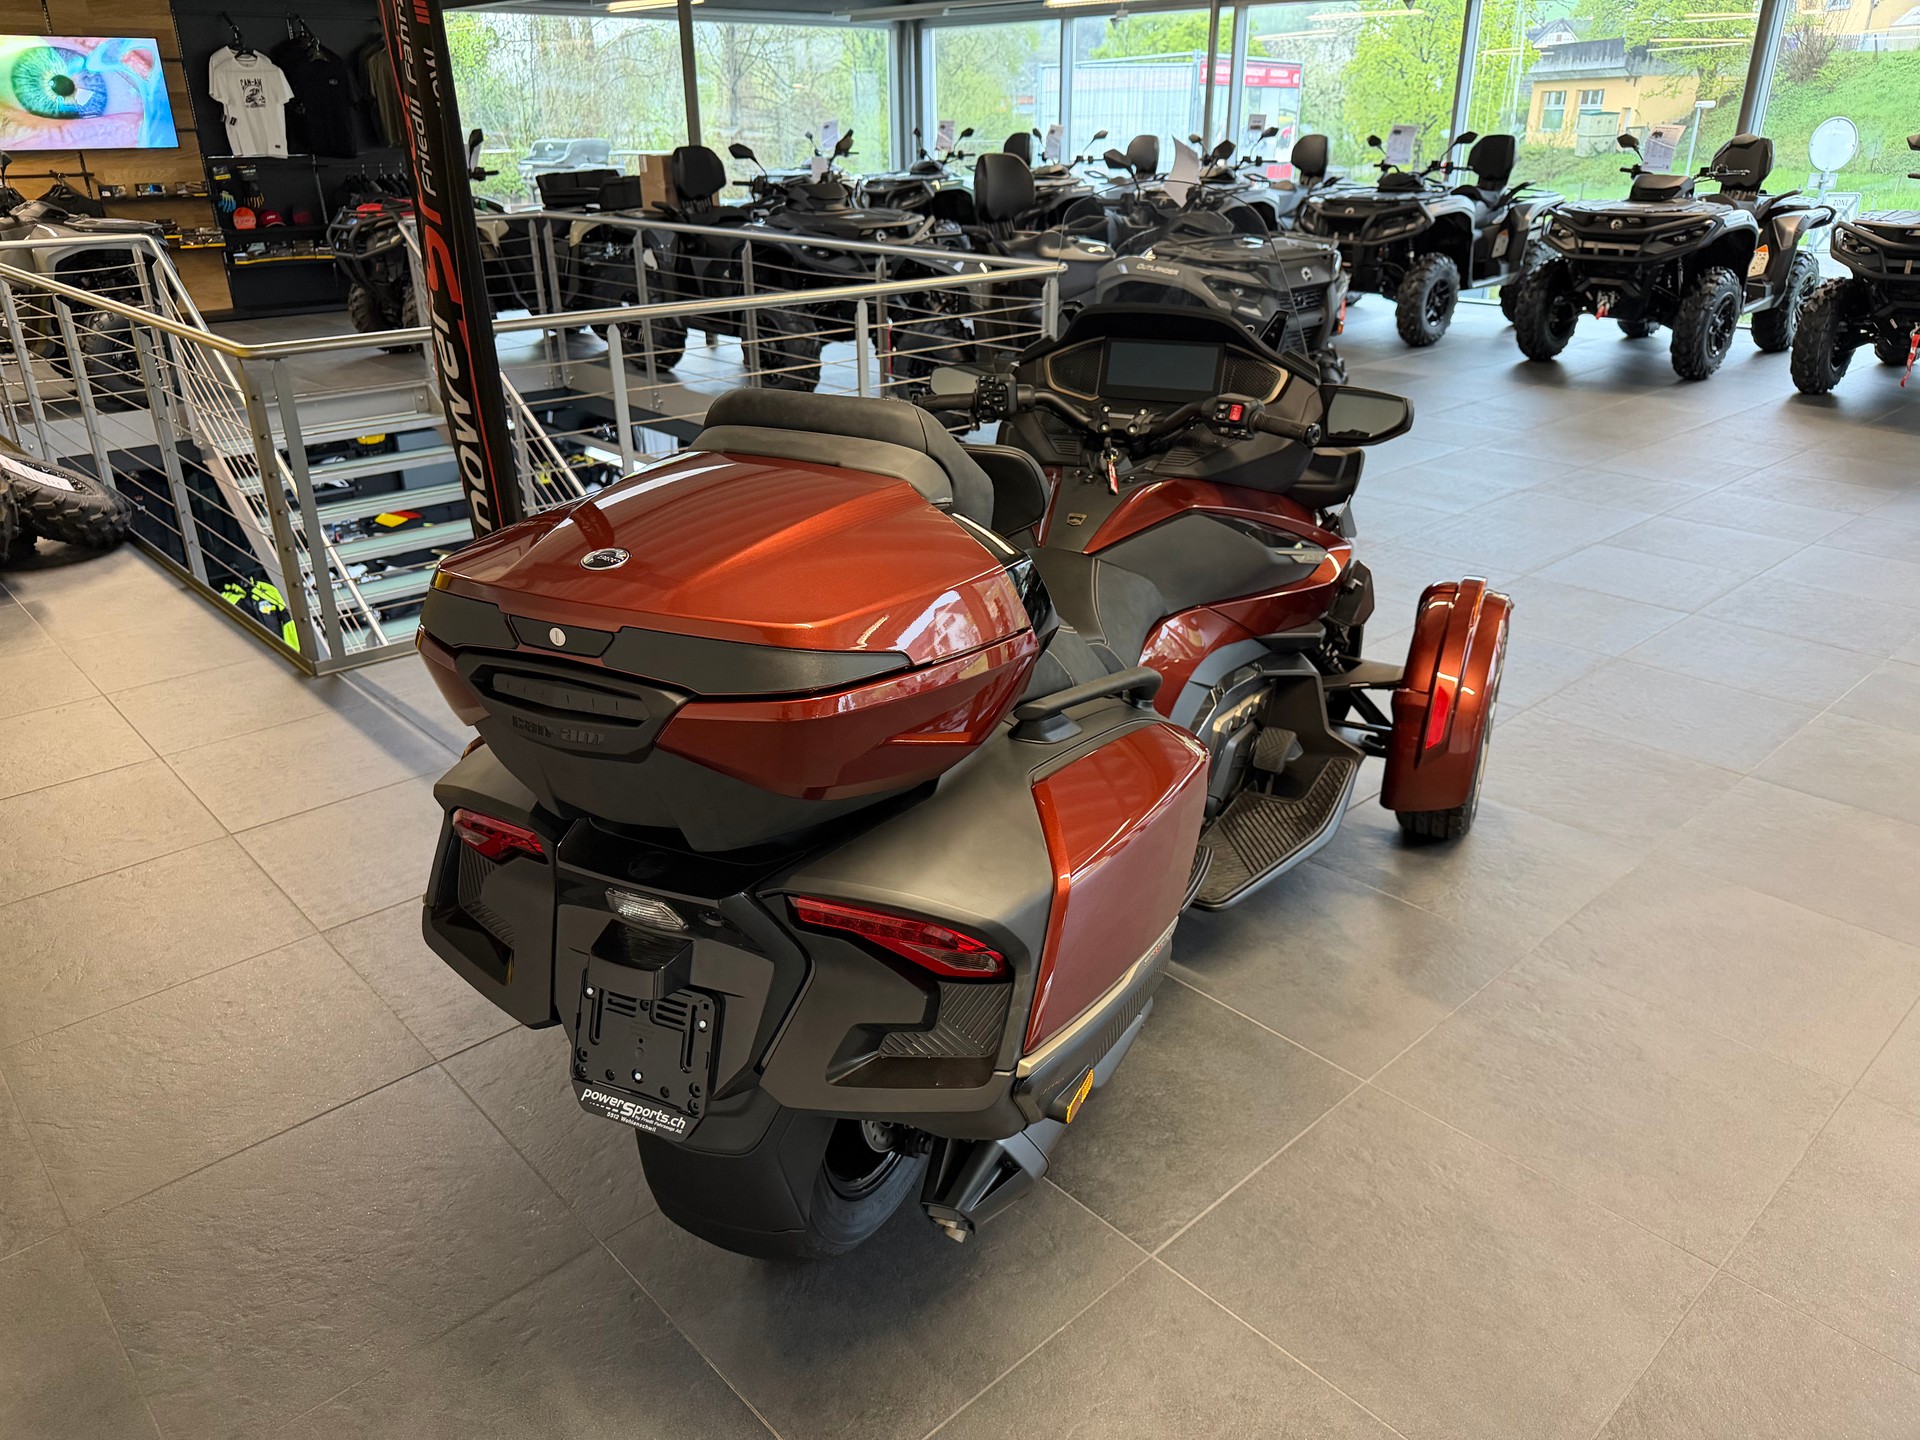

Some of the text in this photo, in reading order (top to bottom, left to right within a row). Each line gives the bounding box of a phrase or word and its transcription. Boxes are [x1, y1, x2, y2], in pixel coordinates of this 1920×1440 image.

[409, 96, 437, 197] Friedli
[1136, 263, 1179, 276] OUTLANDER
[581, 1088, 686, 1129] powerSports.ch
[606, 1111, 620, 1120] 5512
